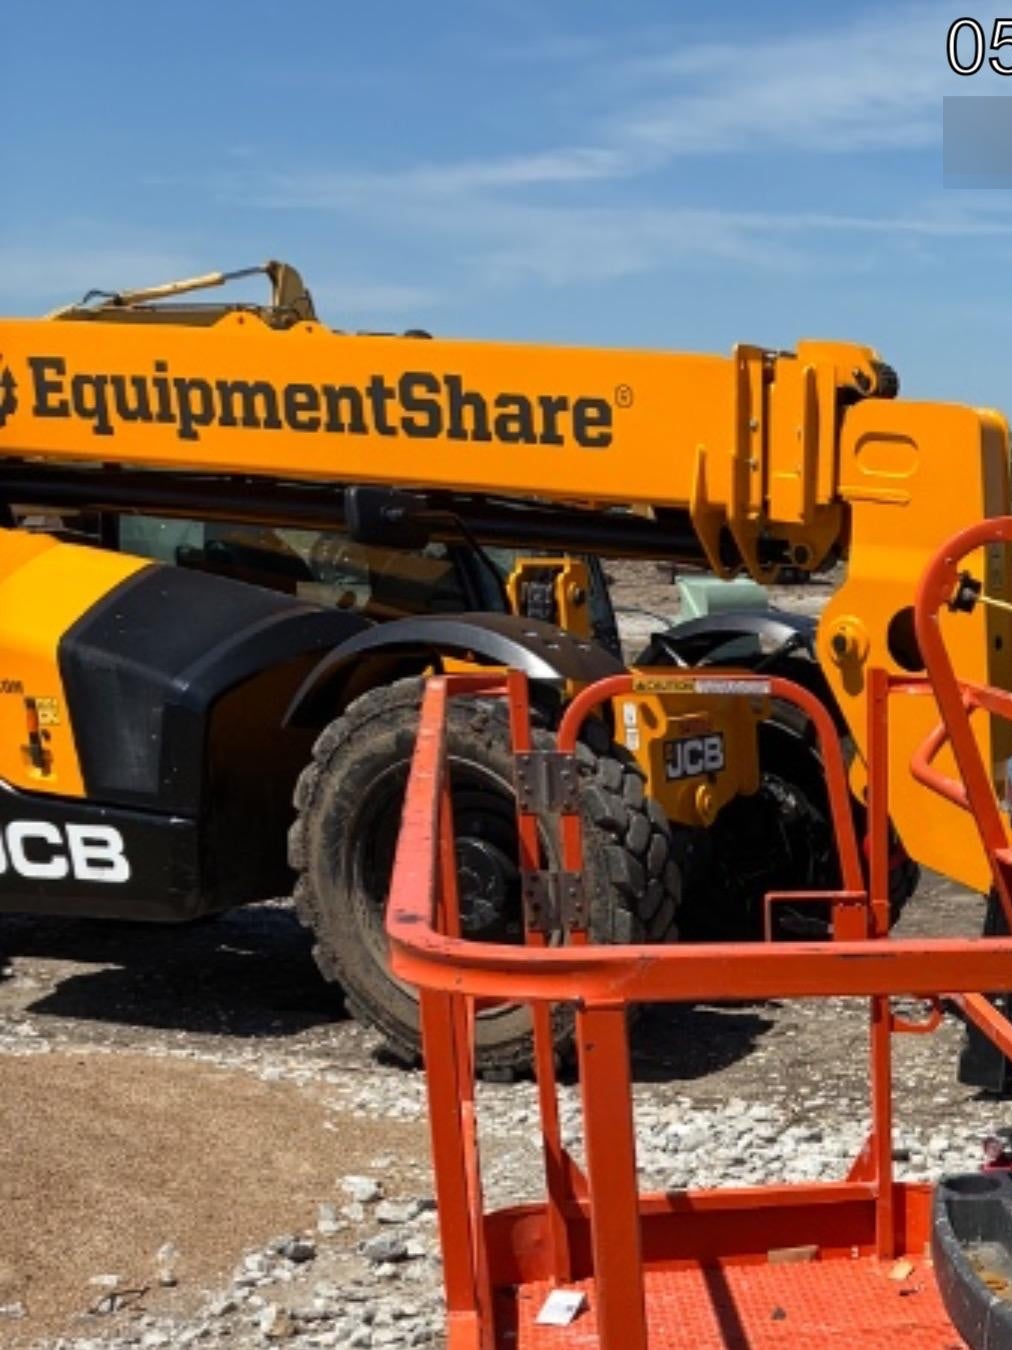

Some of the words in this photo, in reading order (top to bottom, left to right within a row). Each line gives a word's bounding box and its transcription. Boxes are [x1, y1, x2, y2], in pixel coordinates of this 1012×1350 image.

[27, 356, 614, 448] EquipmentShare
[667, 735, 724, 778] JCB
[0, 820, 132, 883] CB
